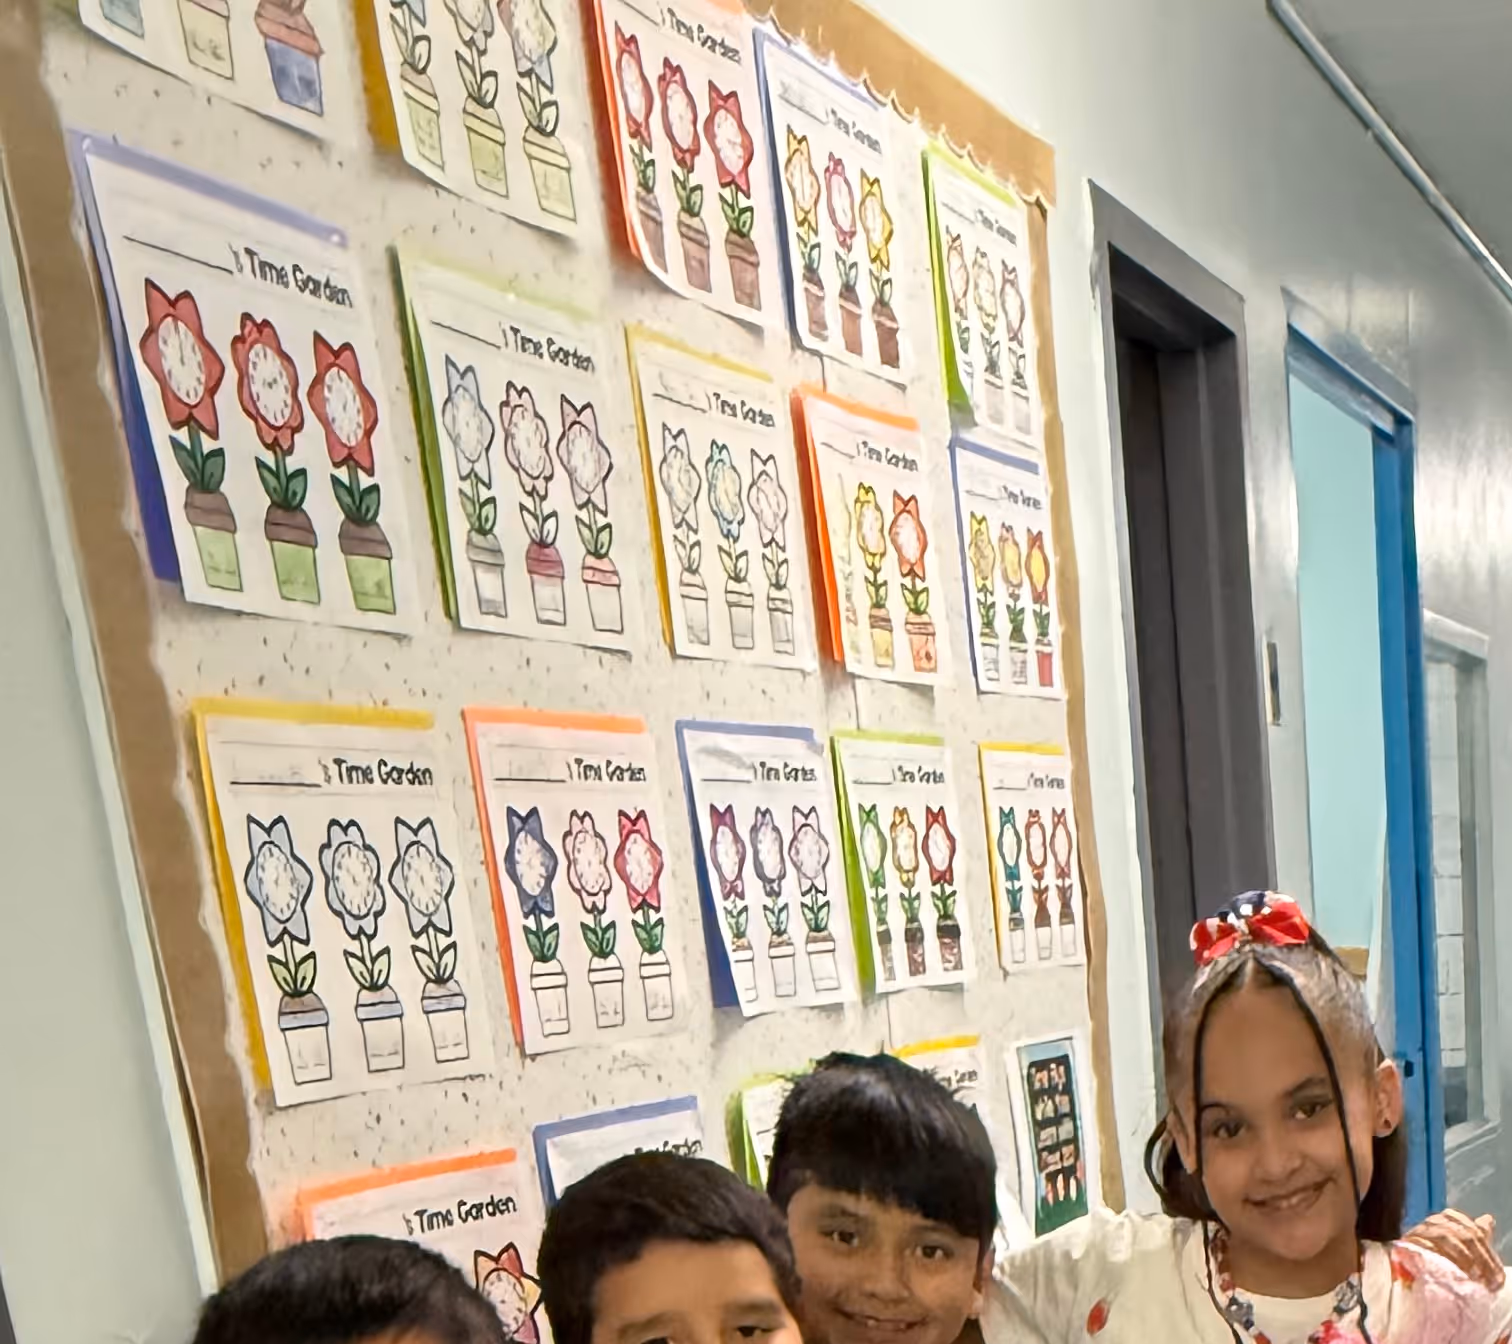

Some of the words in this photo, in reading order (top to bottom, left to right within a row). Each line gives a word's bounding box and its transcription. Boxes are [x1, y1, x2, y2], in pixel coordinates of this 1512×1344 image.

[333, 758, 374, 785] Time
[377, 758, 433, 786] Garden
[414, 1209, 454, 1233] Time
[457, 1194, 517, 1224] Garden
